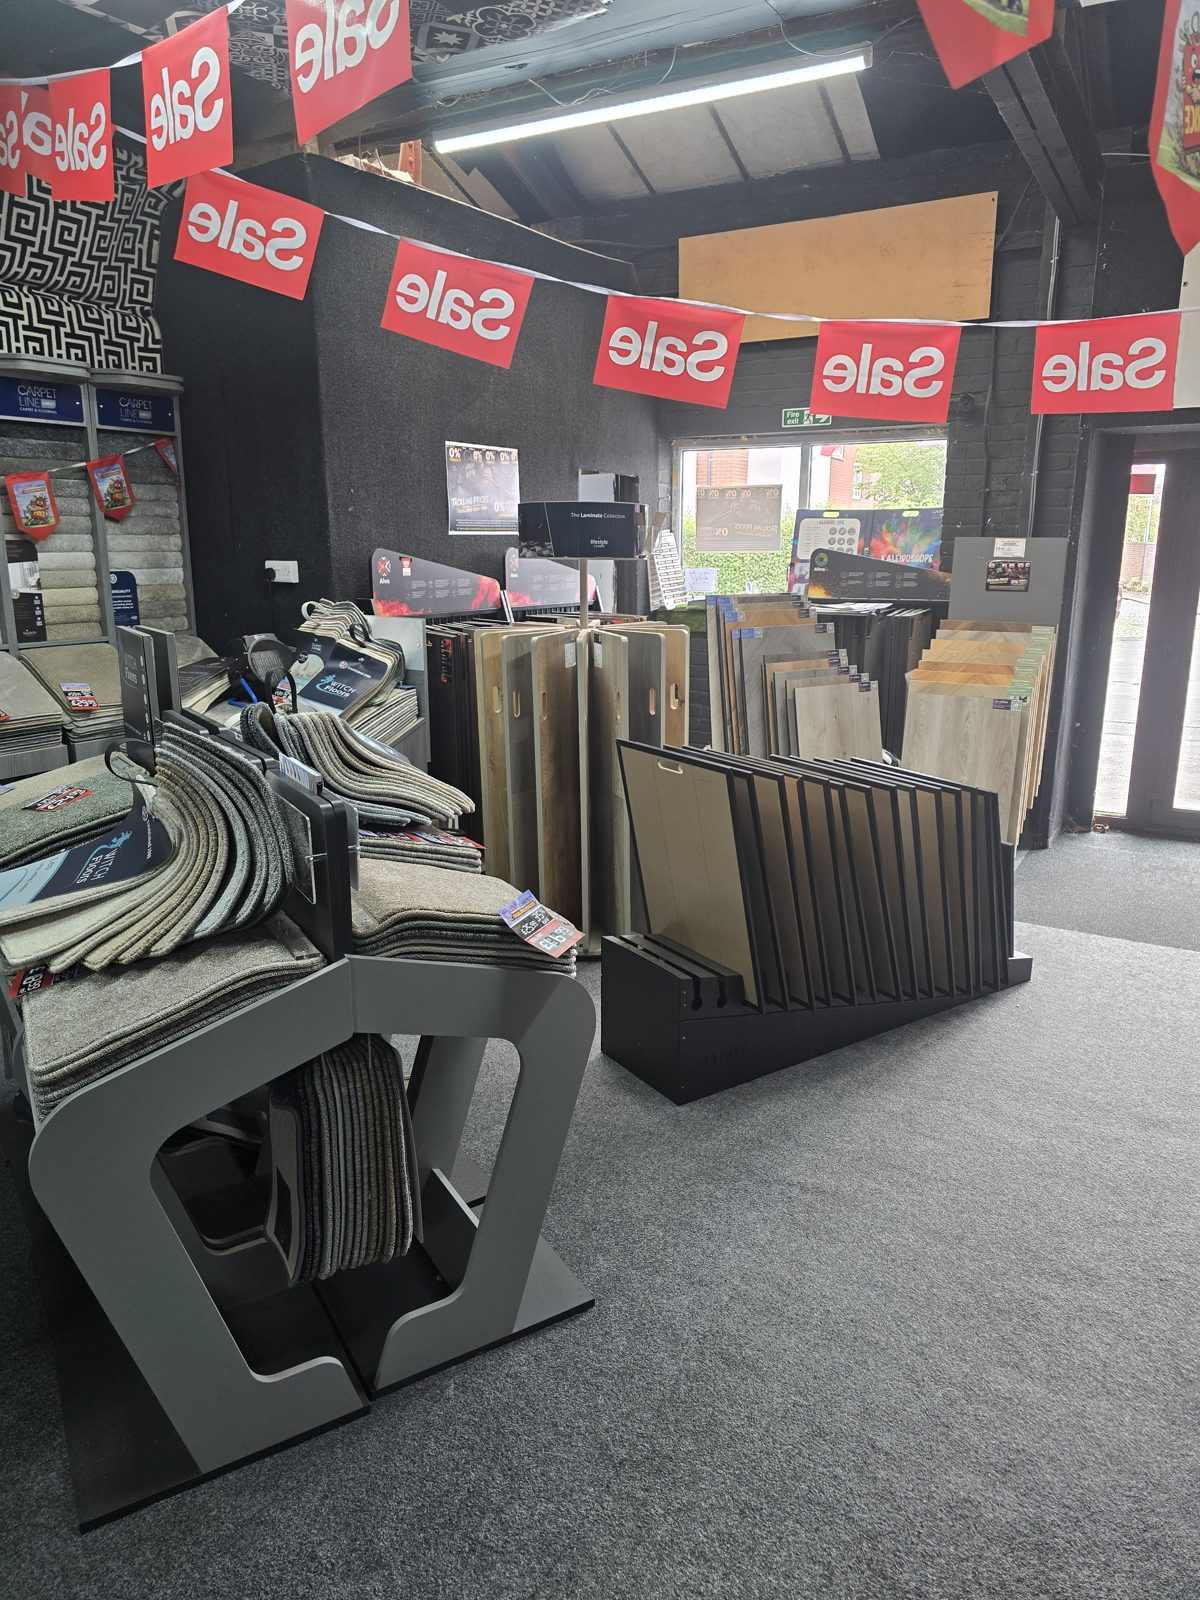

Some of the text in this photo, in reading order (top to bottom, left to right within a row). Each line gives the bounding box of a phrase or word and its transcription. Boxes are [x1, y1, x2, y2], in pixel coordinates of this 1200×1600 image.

[17, 384, 57, 399] CARPET
[18, 396, 41, 408] LINE
[119, 397, 152, 411] CARPET
[323, 685, 351, 698] Floors
[330, 680, 357, 694] WITCH
[76, 854, 103, 884] Floors
[91, 848, 117, 880] WITCH
